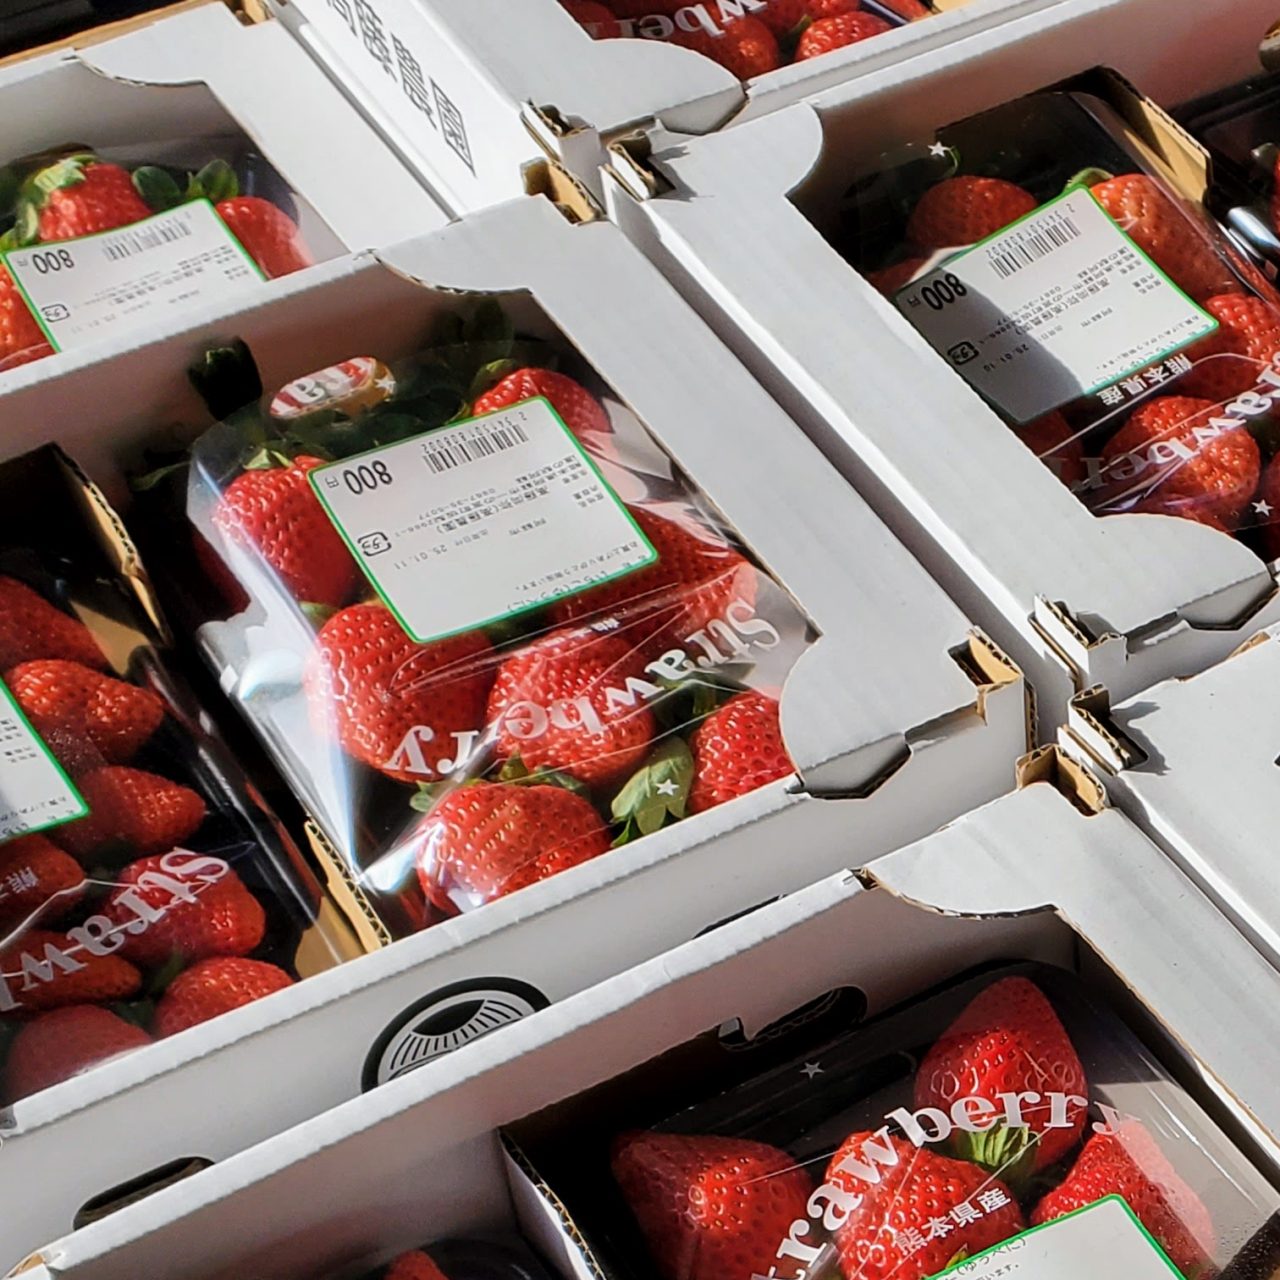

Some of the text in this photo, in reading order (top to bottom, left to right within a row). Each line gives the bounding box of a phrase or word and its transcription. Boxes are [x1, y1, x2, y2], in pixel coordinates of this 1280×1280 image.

[32, 249, 74, 274] 800
[921, 273, 967, 310] 800
[1096, 353, 1193, 406] 熊本県産
[343, 460, 392, 495] 800
[893, 1187, 1012, 1257] 熊本県産
